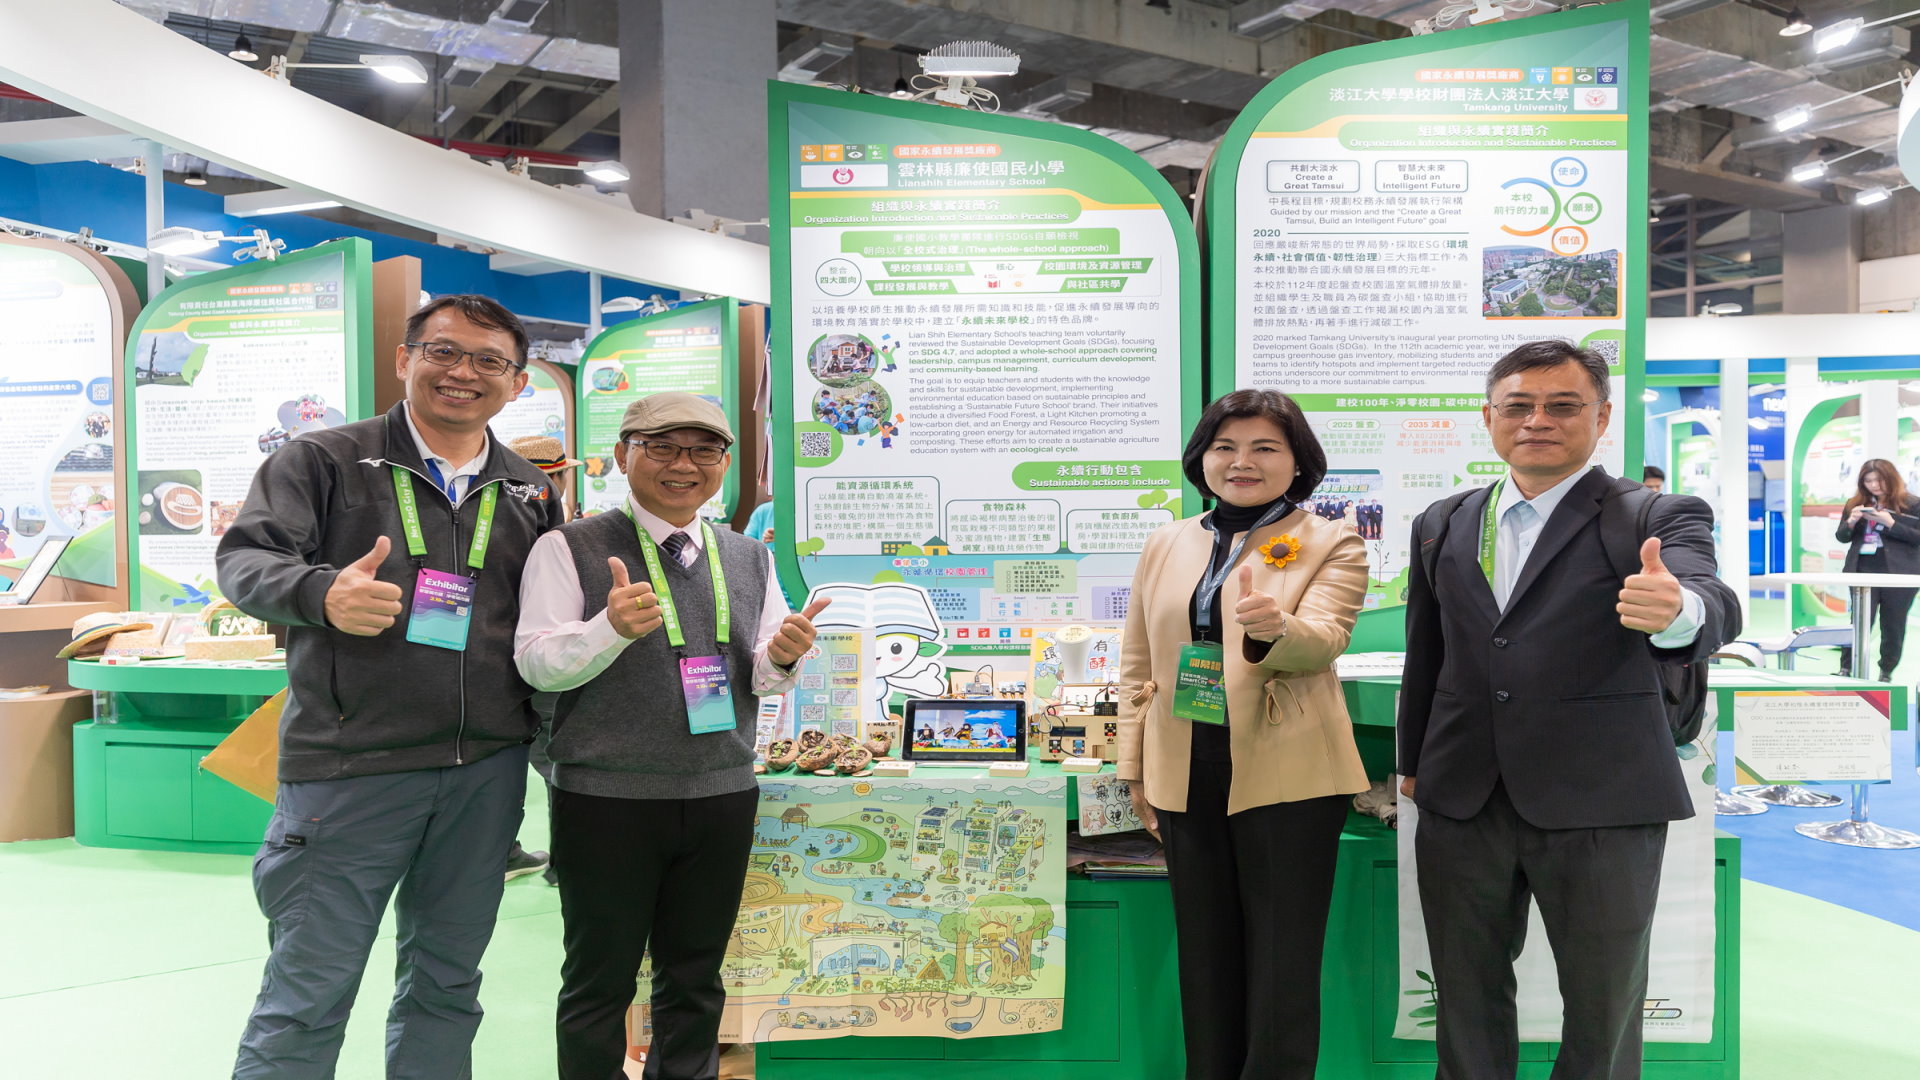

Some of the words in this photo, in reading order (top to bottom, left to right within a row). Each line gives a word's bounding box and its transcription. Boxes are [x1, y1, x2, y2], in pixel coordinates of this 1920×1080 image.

[1329, 88, 1568, 102] 淡江大學學校財團法人淡江大學
[1462, 103, 1510, 112] Tamkang
[1514, 103, 1567, 112] University
[1349, 138, 1416, 147] Organization
[1483, 138, 1503, 148] and
[1505, 138, 1566, 146] Sustainable
[898, 160, 1064, 177] 雲林縣廉使國民小學
[1290, 164, 1338, 172] 共創大淡水
[1558, 166, 1580, 178] 使命
[898, 179, 943, 187] Lianshih
[946, 178, 1005, 187] Elementary
[1008, 177, 1045, 185] School
[1283, 182, 1308, 191] Great
[1311, 182, 1344, 191] Tamsui
[1382, 182, 1427, 191] Intelligent
[1431, 182, 1460, 191] Future
[1511, 192, 1533, 203] 本校
[1302, 208, 1312, 217] by
[1363, 207, 1379, 215] and
[1381, 207, 1395, 215] the
[1438, 207, 1461, 215] Great
[1493, 204, 1550, 216] 前行的力量
[1572, 201, 1594, 213] 願景
[1285, 217, 1317, 225] Tamsui,
[1355, 216, 1394, 226] Intelligent
[1428, 216, 1446, 226] goal
[1253, 229, 1280, 237] 2020
[1558, 234, 1580, 246] 價值
[988, 245, 1056, 255] whole-school
[1059, 244, 1109, 256] approach)
[947, 330, 992, 339] Elementary
[1028, 330, 1062, 339] teaching
[1085, 329, 1125, 338] voluntarily
[945, 339, 958, 347] the
[1008, 338, 1060, 347] Development
[1121, 337, 1154, 346] focusing
[976, 347, 1010, 357] adopted
[1078, 346, 1118, 355] approach
[1120, 346, 1157, 355] covering
[909, 356, 955, 366] leadership,
[957, 357, 991, 365] campus
[993, 356, 1050, 365] management,
[1052, 355, 1097, 363] curriculum
[1099, 355, 1157, 364] development,
[925, 365, 1001, 375] community-based
[1003, 365, 1040, 374] learning.
[1252, 378, 1300, 387] contributing
[1392, 378, 1425, 386] campus.
[1057, 464, 1142, 476] 永續行動包含
[1029, 478, 1089, 486] Sustainable
[1132, 477, 1170, 487] include
[982, 502, 1027, 512] 食物森林
[425, 578, 468, 593] Exhibitor
[687, 665, 721, 675] Exhibitor
